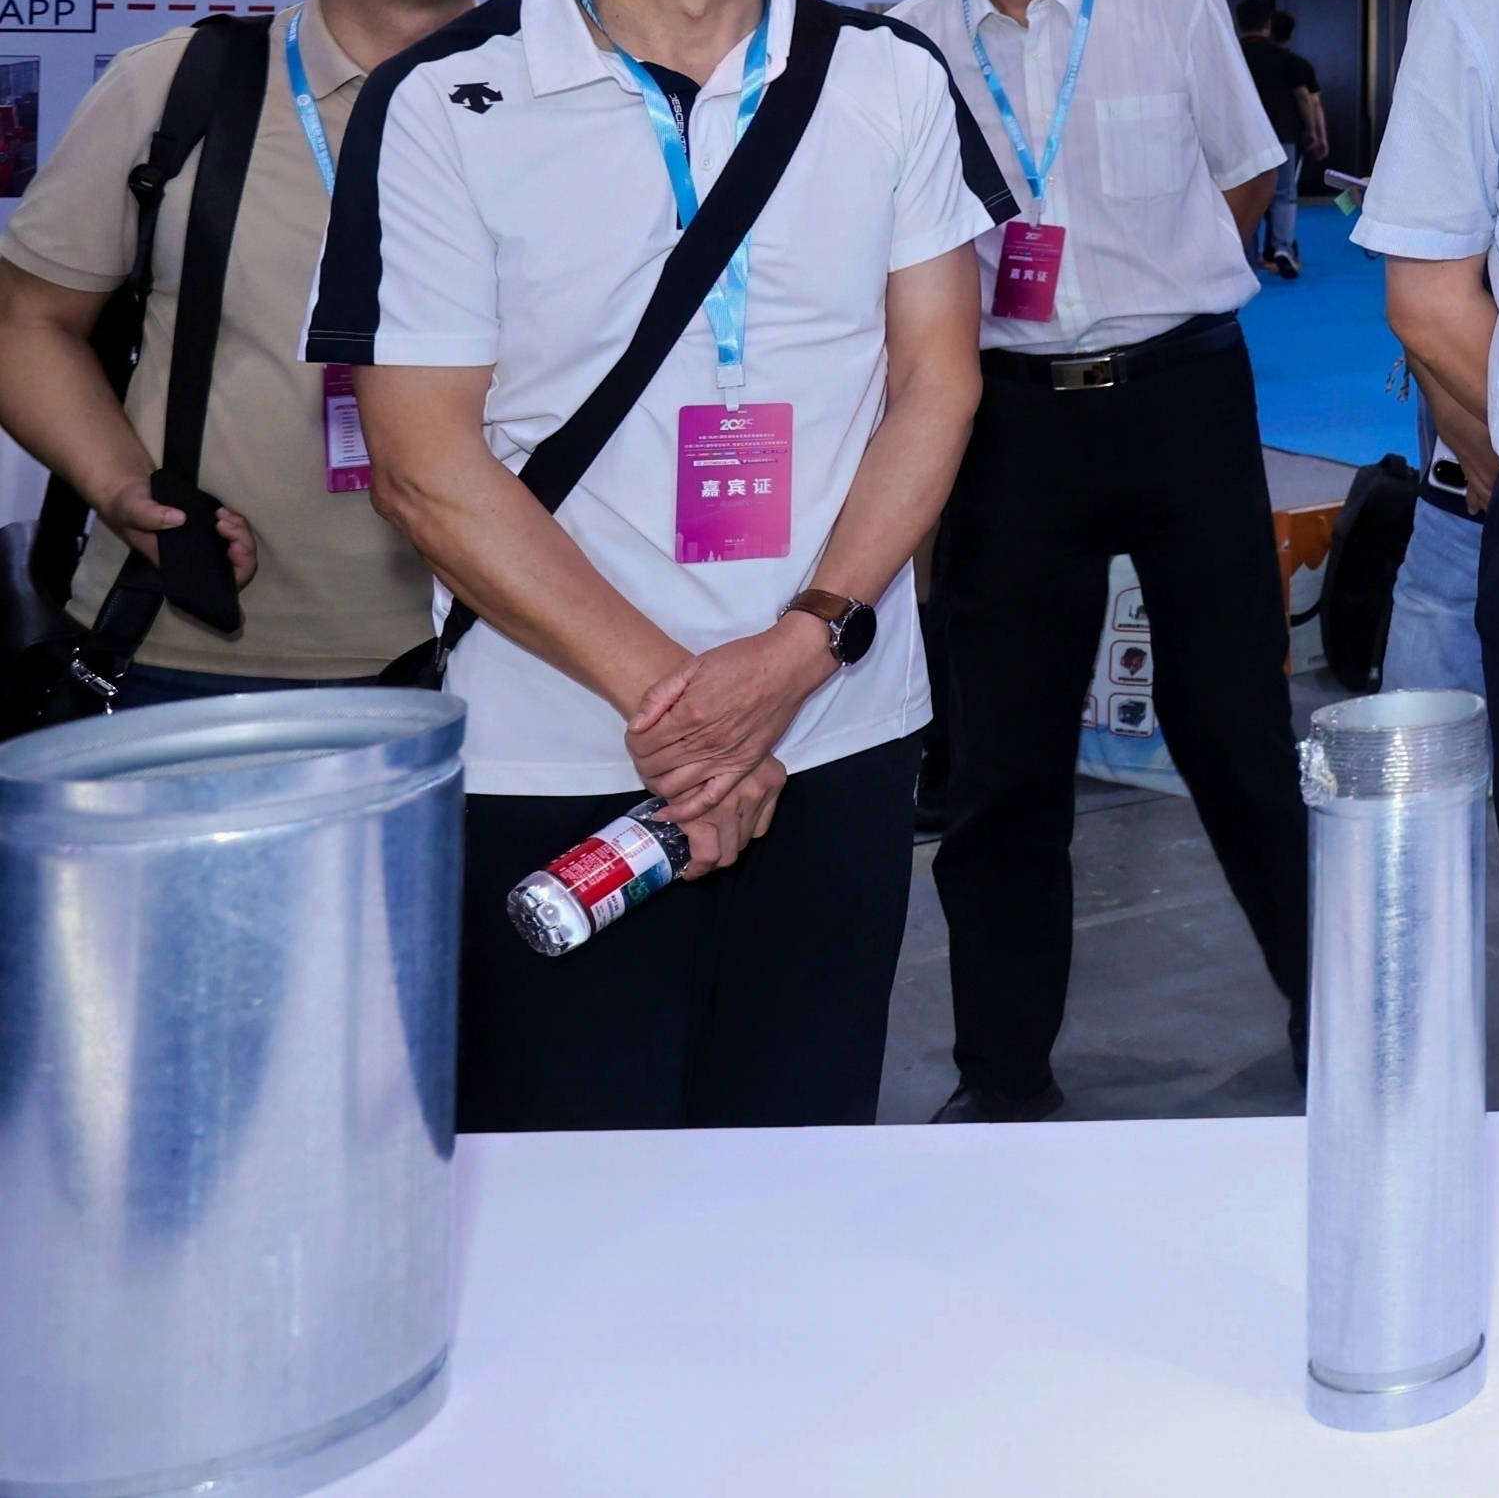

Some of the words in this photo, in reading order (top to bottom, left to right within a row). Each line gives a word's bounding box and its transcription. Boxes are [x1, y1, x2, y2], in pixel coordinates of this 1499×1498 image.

[1009, 268, 1049, 282] 嘉宾证
[701, 478, 772, 497] 嘉宾证
